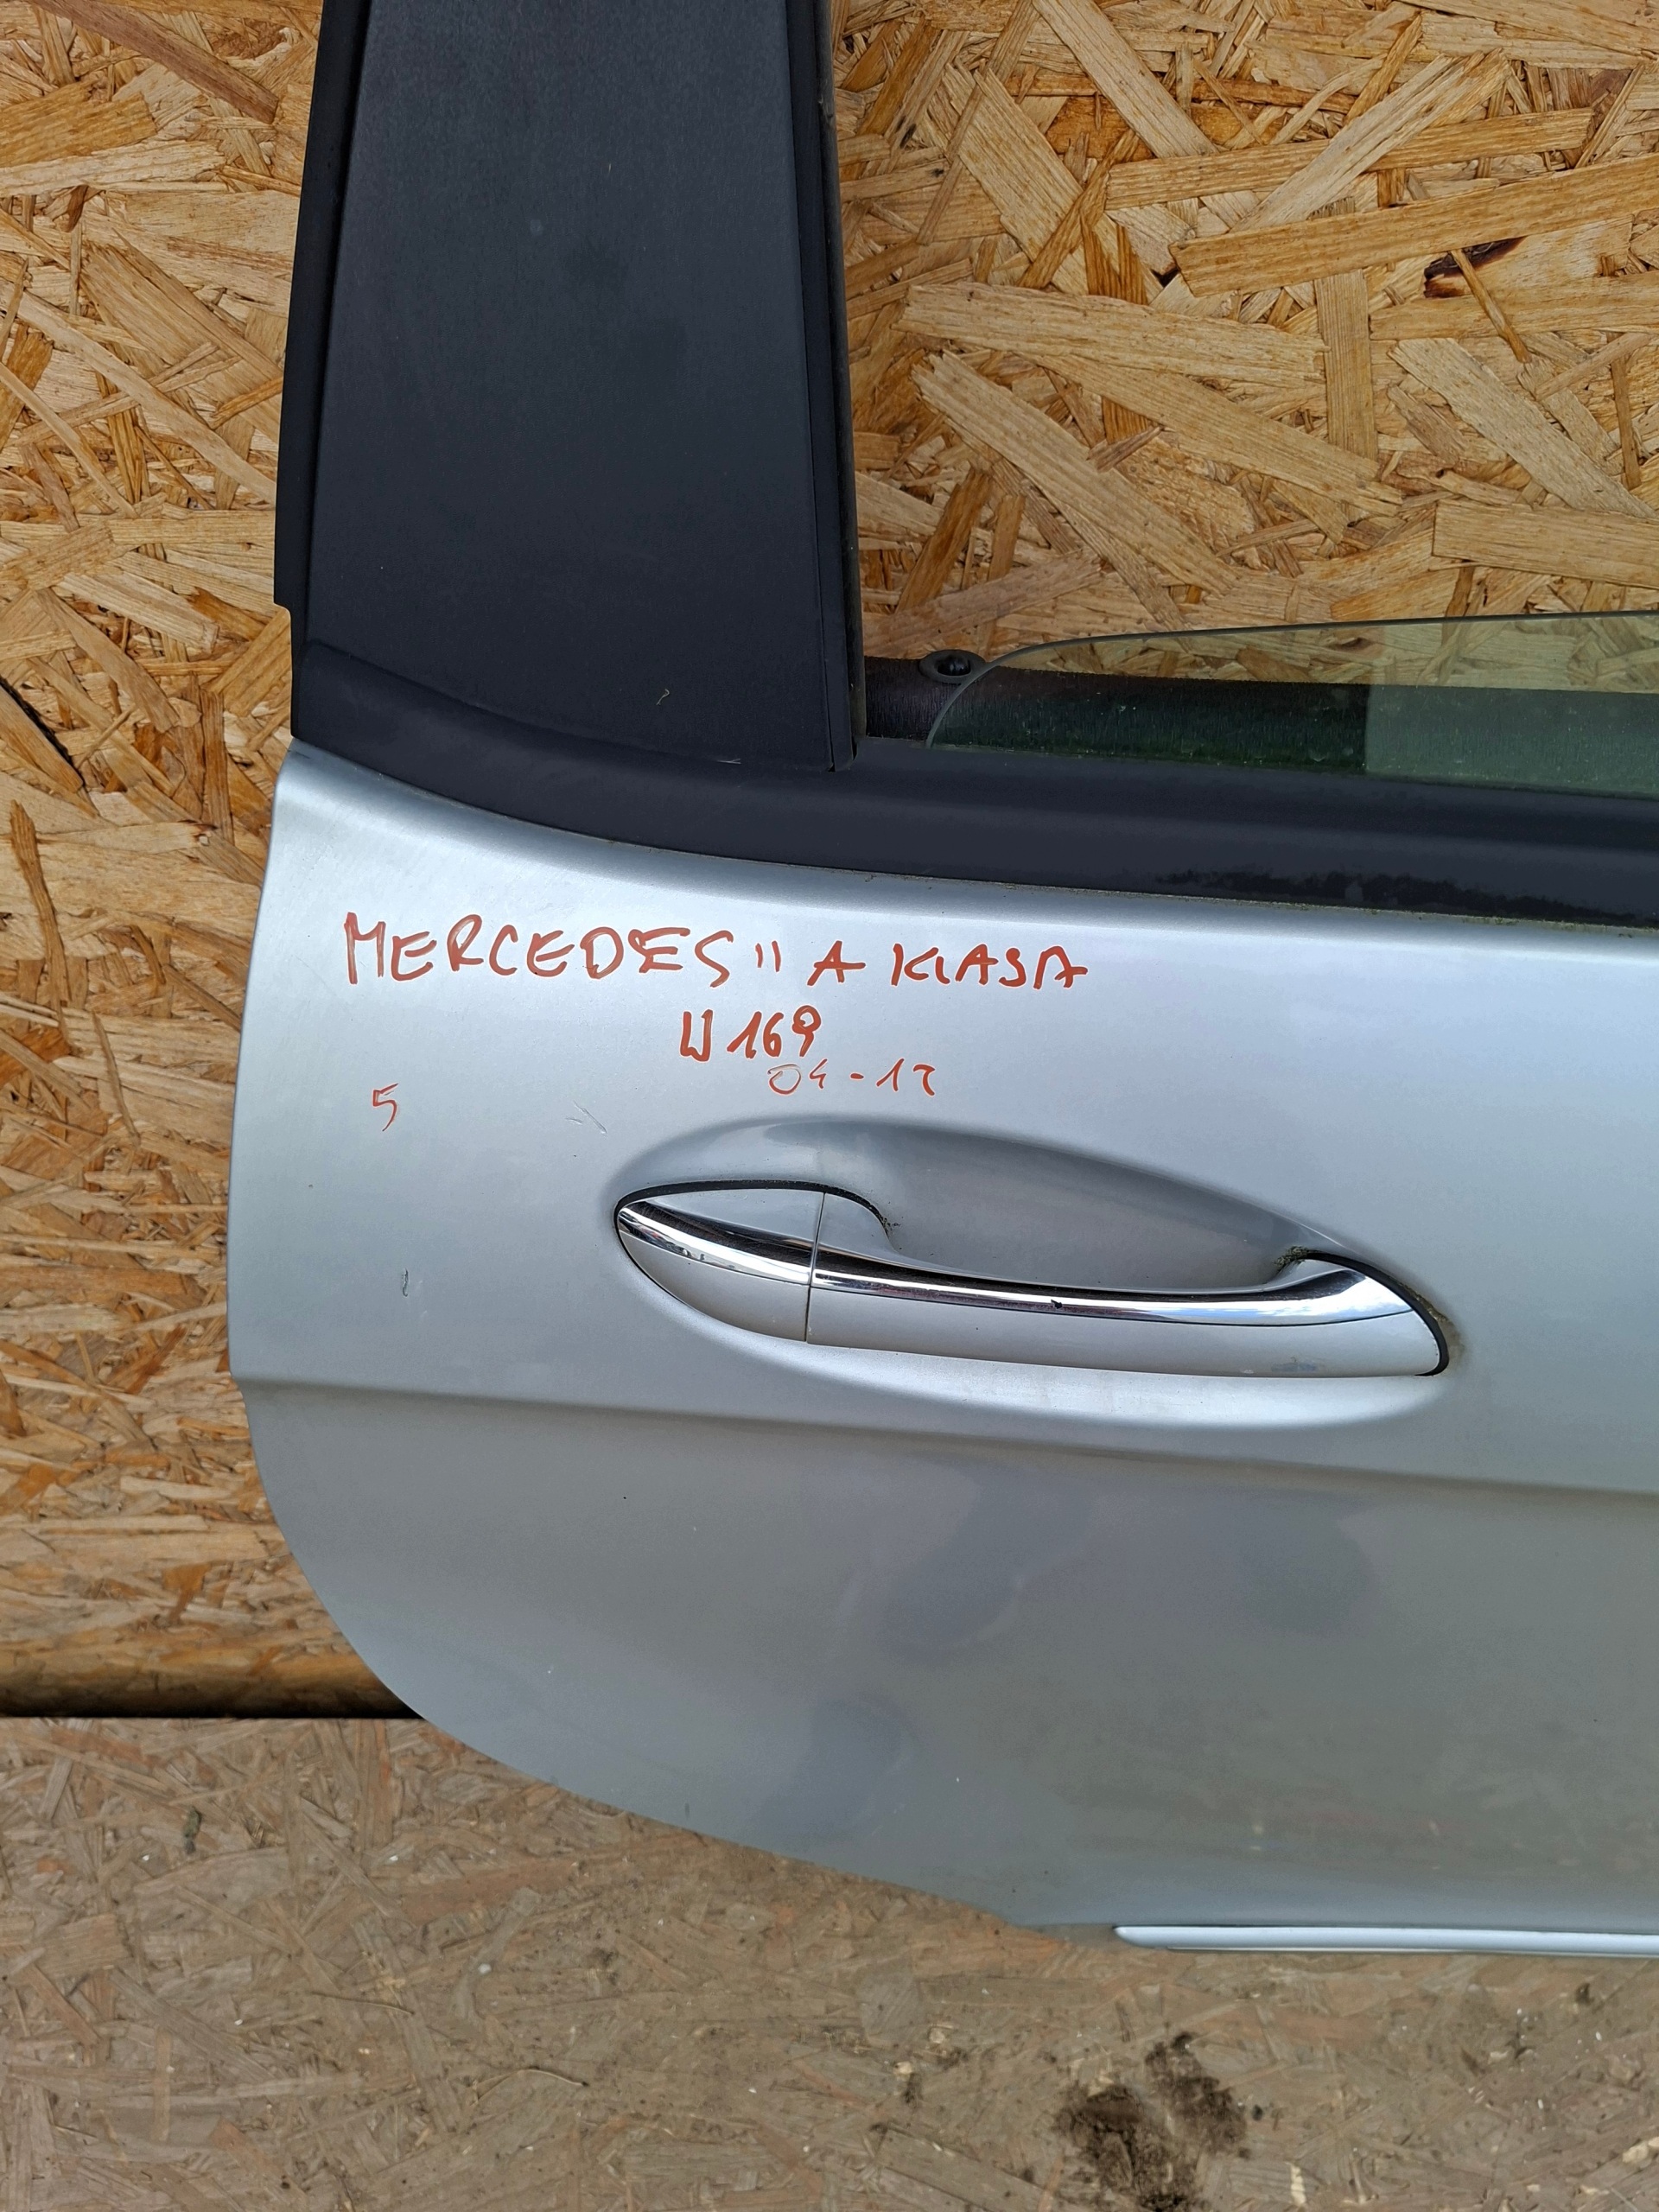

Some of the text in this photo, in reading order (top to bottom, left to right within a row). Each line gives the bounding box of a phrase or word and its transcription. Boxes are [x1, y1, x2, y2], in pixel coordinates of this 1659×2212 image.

[343, 912, 734, 988] MERCEDES
[806, 939, 867, 987] A
[890, 942, 1089, 991] KLASA
[371, 1082, 399, 1132] 5
